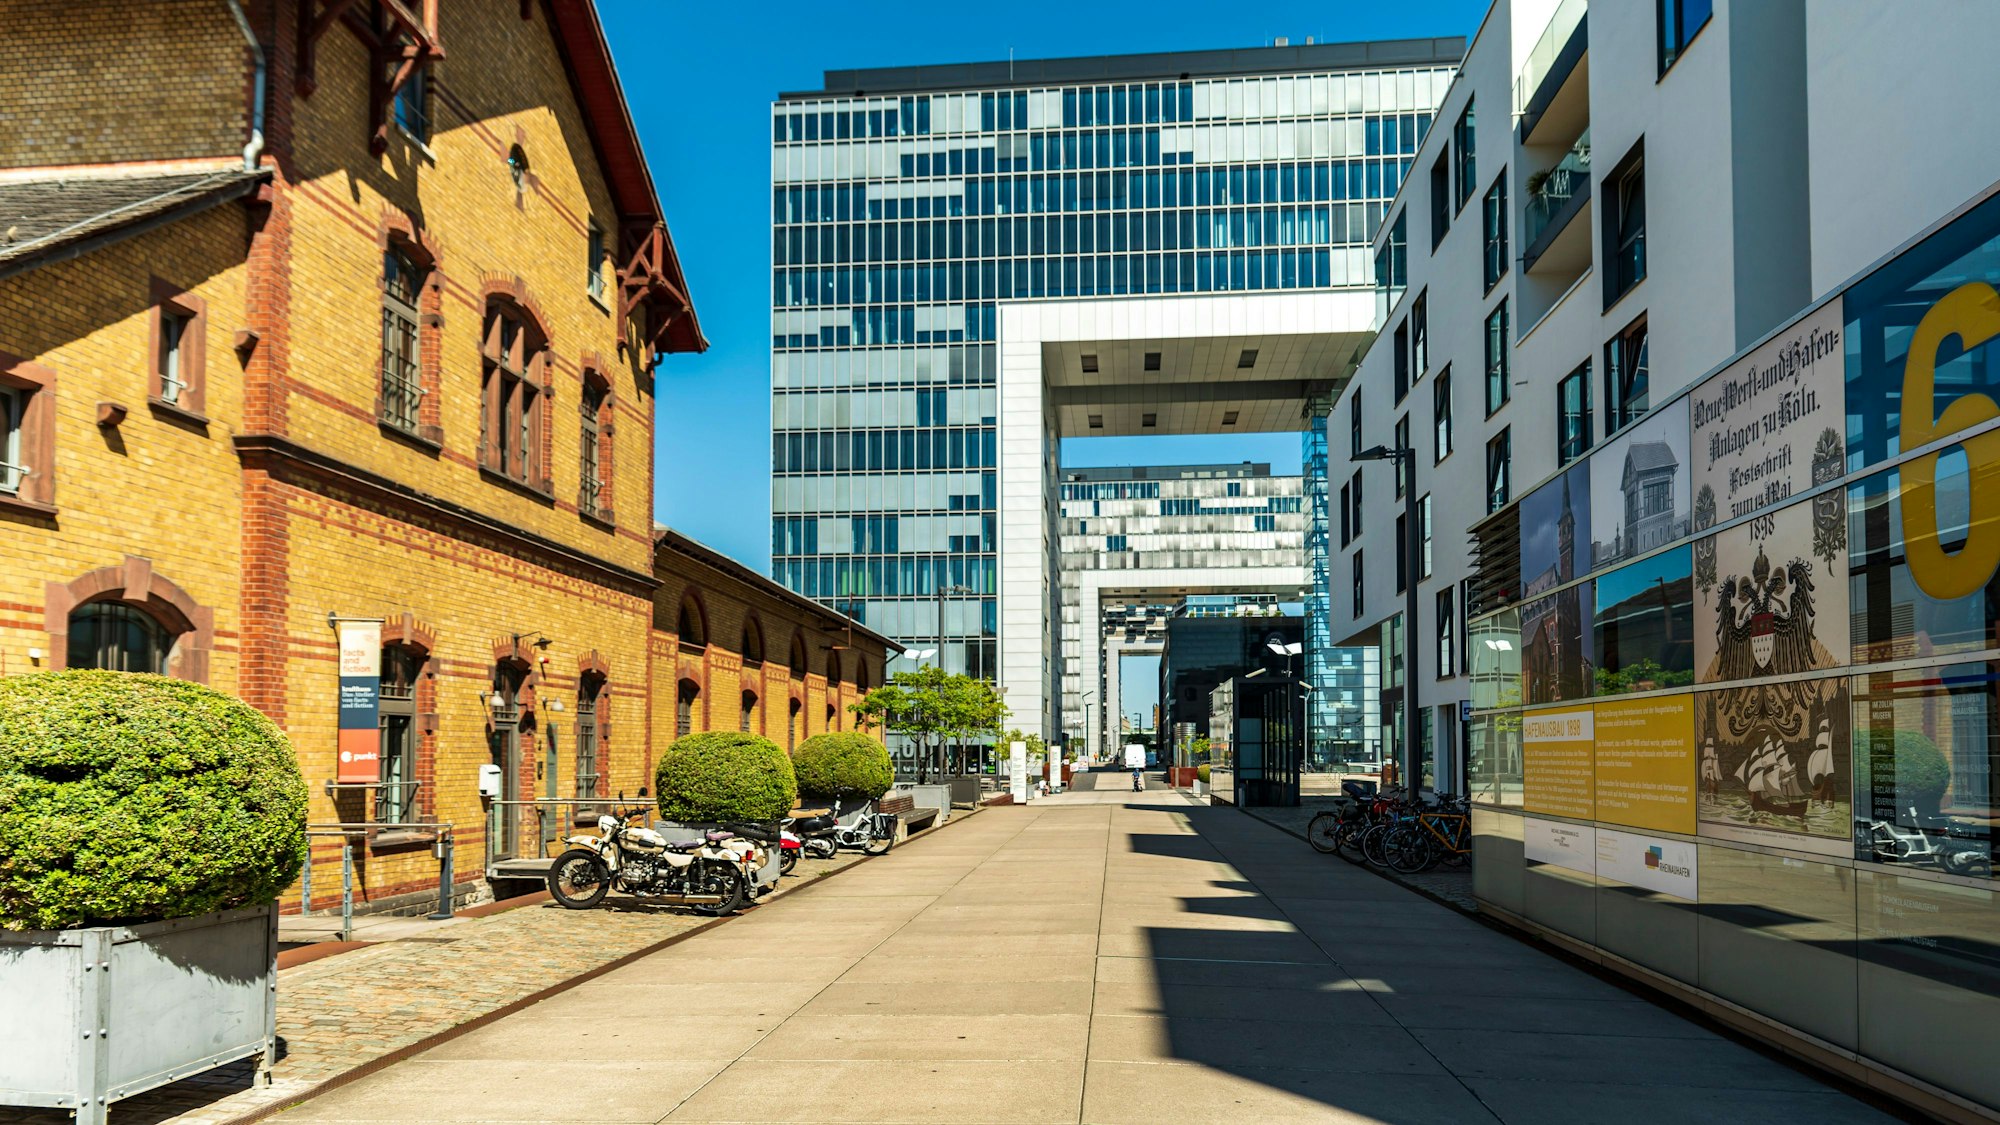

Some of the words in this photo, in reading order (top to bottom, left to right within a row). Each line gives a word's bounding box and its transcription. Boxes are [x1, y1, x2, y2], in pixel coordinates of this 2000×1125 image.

[1707, 420, 1760, 471] Anlagen
[1762, 411, 1776, 446] zu
[1899, 281, 2000, 601] 6
[1728, 441, 1792, 500] Festschrift
[1749, 513, 1775, 545] 1898
[343, 649, 365, 657] facts
[343, 665, 371, 673] fiction
[1525, 721, 1564, 738] HAFENAUSBAU
[353, 752, 377, 762] punkt
[1659, 862, 1690, 878] RHEINAUHAFEN
